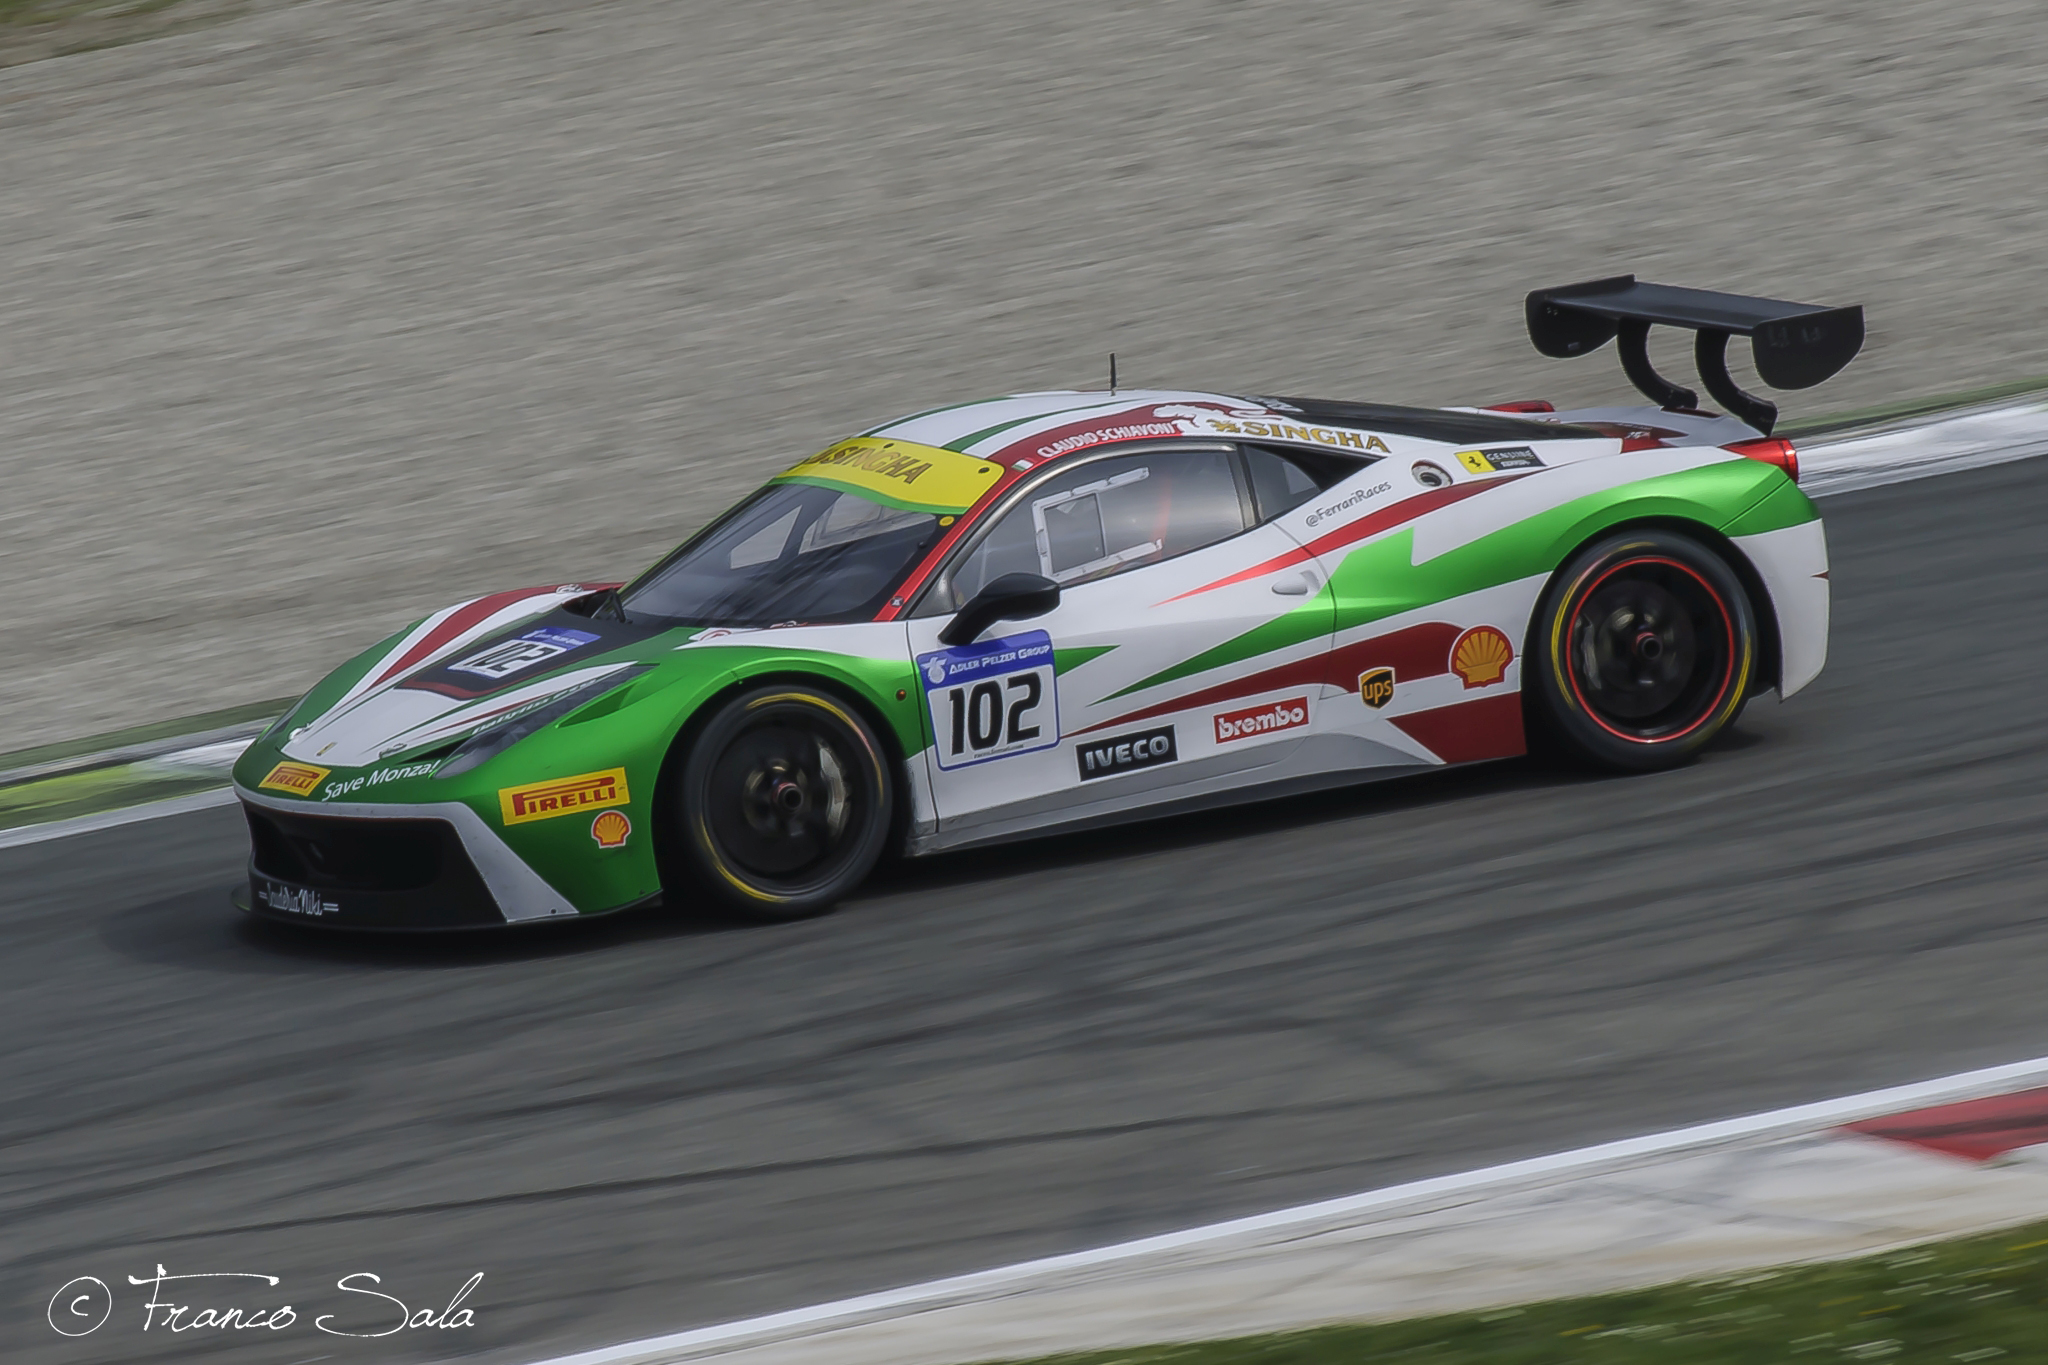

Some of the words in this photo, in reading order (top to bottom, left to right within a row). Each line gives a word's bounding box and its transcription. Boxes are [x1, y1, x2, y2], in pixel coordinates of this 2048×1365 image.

[1037, 432, 1099, 458] CLAUDIO
[1096, 422, 1175, 441] SCHIAVONI
[1243, 420, 1391, 453] SINGHA
[820, 446, 933, 485] SINGHA
[1305, 481, 1392, 527] @FerrariRaces
[948, 659, 980, 675] ADLER
[981, 650, 1016, 668] PELZER
[1363, 680, 1392, 705] ups
[948, 671, 1042, 757] 102
[1218, 706, 1305, 740] brembo
[1085, 735, 1170, 771] IVECO
[266, 766, 320, 789] PIRELLI
[321, 776, 365, 802] Save
[366, 759, 442, 788] Monza!
[512, 776, 616, 817] PIRELLI
